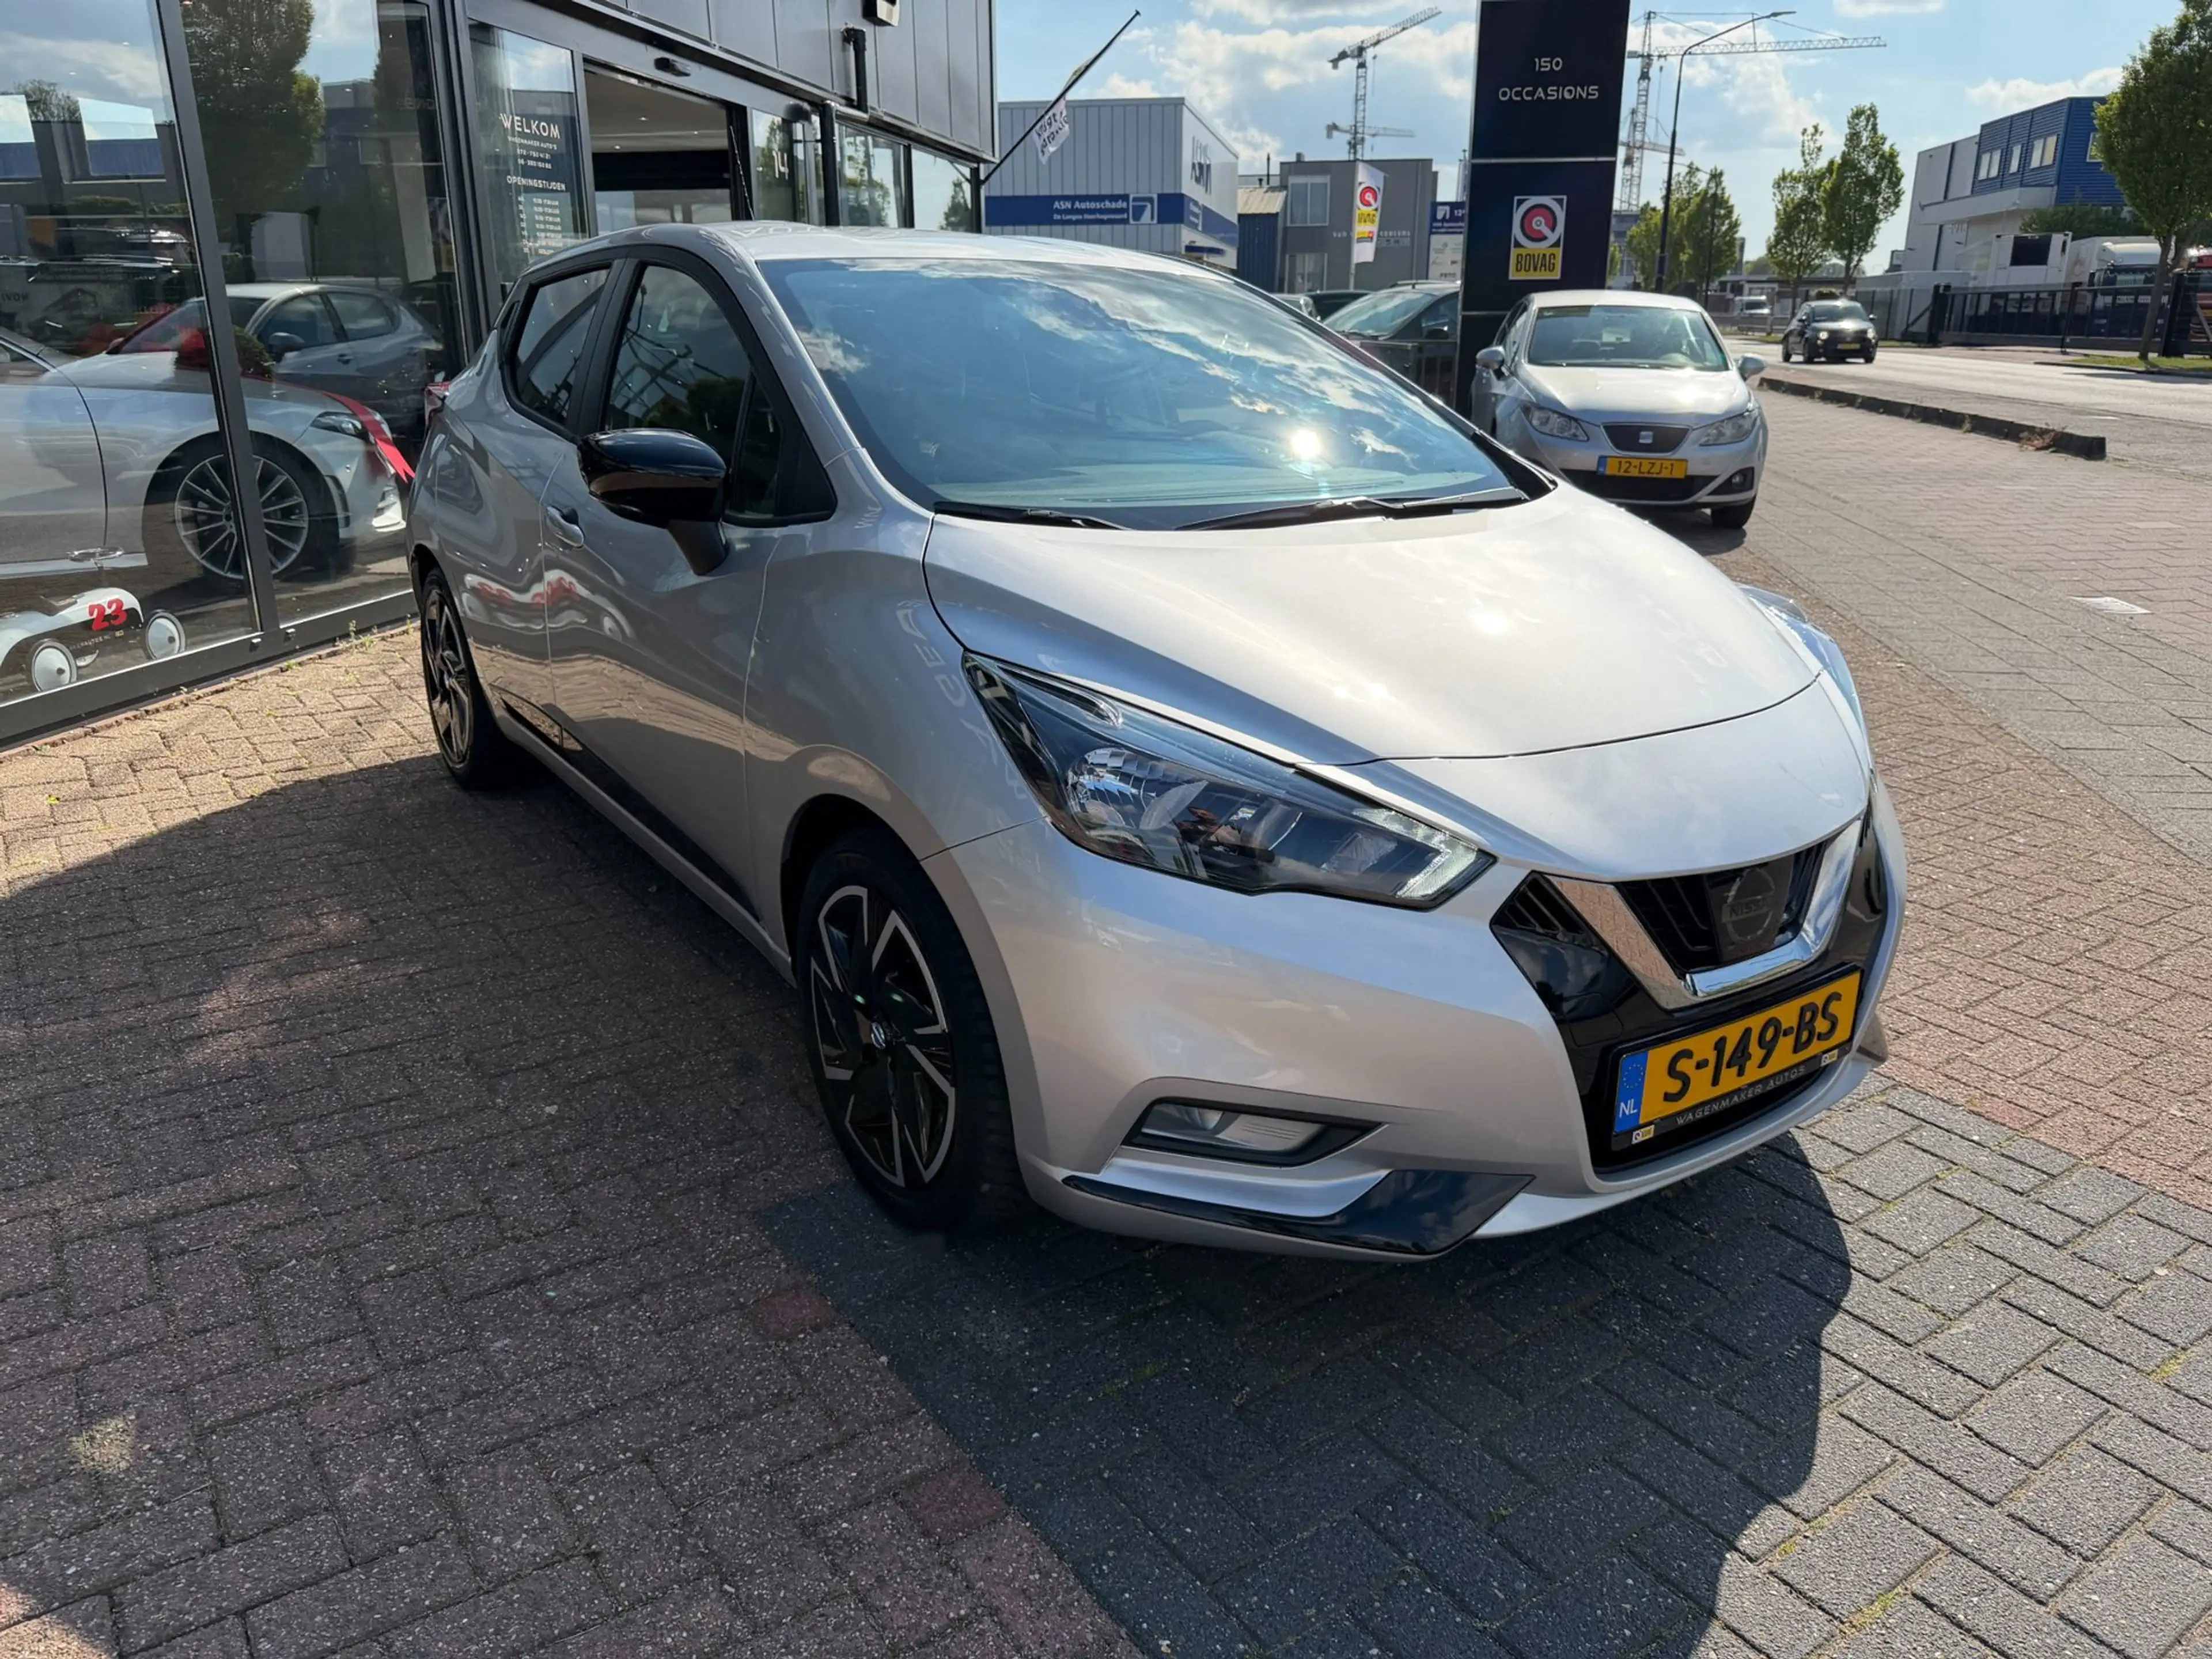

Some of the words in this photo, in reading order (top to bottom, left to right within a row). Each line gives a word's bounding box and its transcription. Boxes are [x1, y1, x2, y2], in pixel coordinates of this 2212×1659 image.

[1534, 57, 1563, 72] 150
[1498, 86, 1599, 101] OCCASIONS
[500, 113, 560, 139] WELKOM
[772, 150, 789, 180] 14
[507, 175, 566, 191] OPENINGSTIJDEN
[1053, 200, 1071, 210] ASN
[1073, 199, 1127, 209] Autoschade
[1515, 252, 1556, 273] BOVAG
[1617, 460, 1674, 475] 12-LZJ-1
[88, 597, 127, 631] 23
[1663, 991, 1842, 1103] S-149-BS
[1618, 1098, 1638, 1118] NL
[1676, 1085, 1762, 1125] WAGENMAKER
